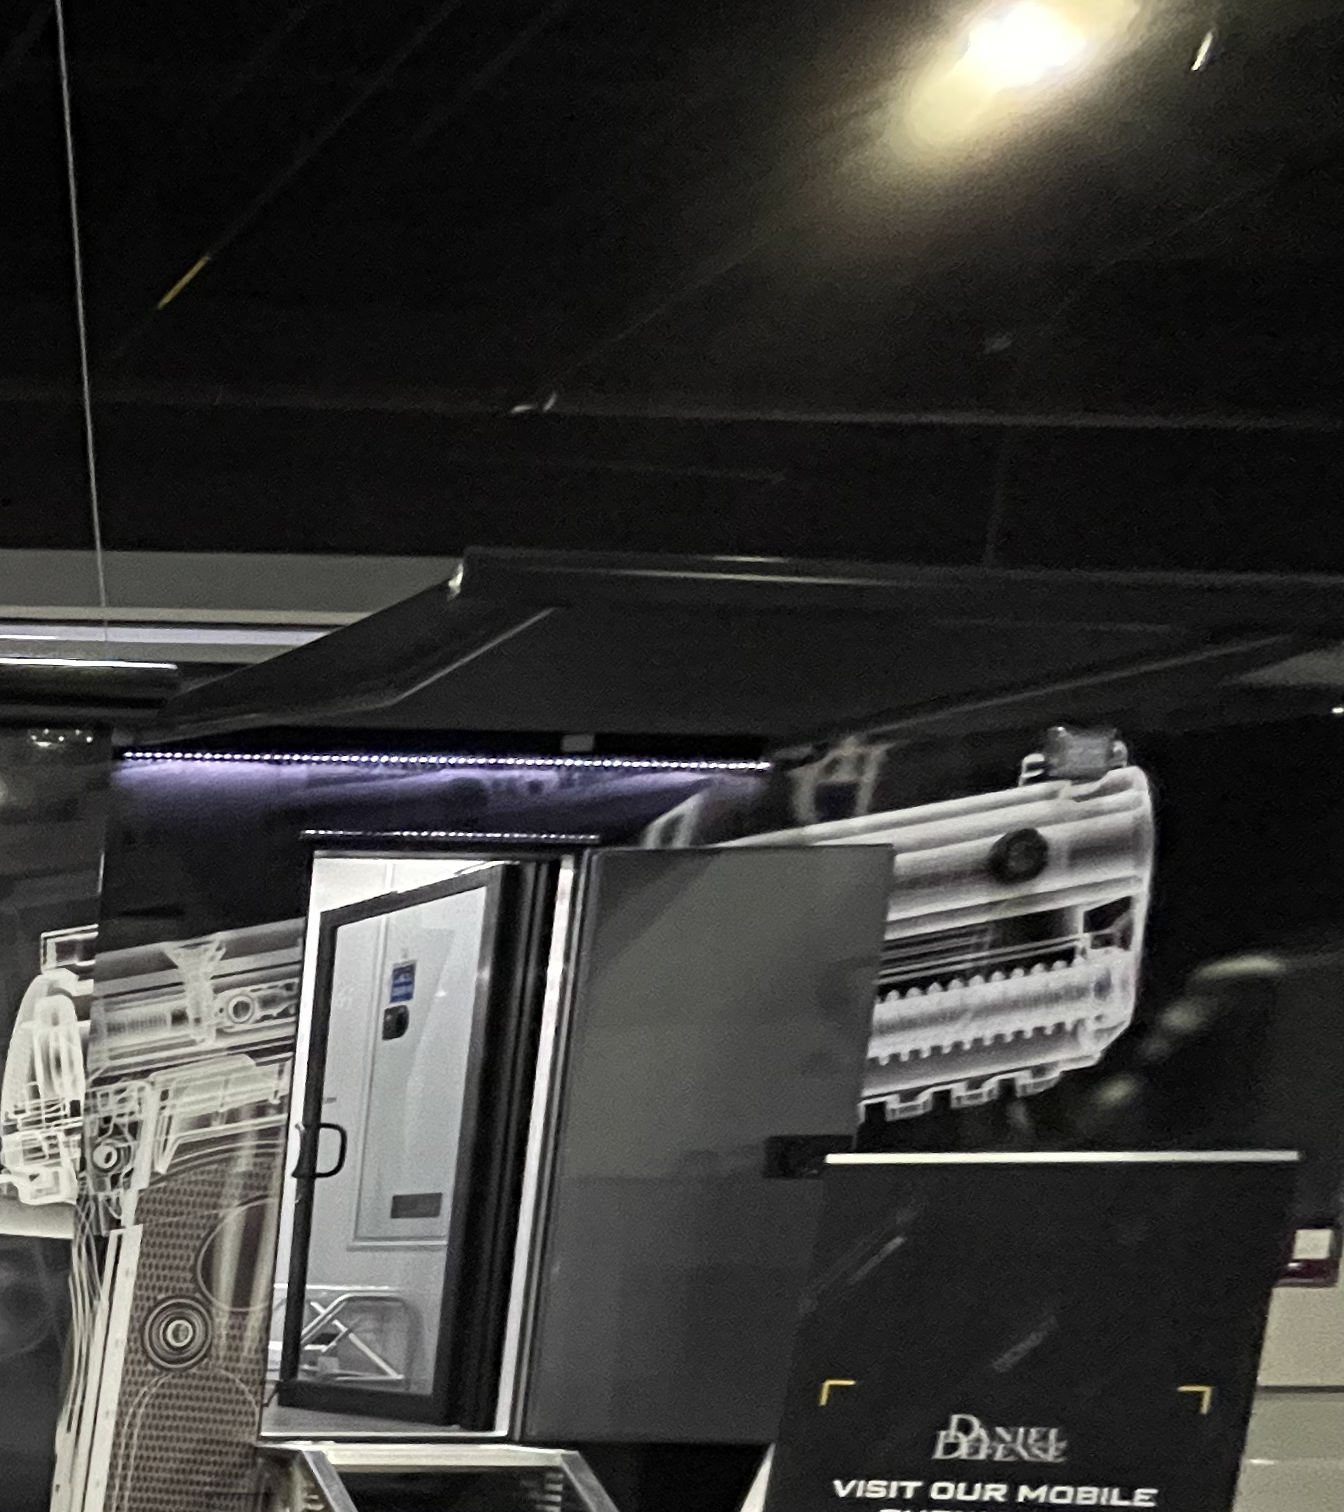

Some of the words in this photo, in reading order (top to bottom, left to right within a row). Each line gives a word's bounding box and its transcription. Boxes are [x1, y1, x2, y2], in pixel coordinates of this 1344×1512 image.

[832, 1479, 924, 1499] VISIT
[929, 1481, 1009, 1502] OUR
[1016, 1484, 1159, 1508] MOBILE
